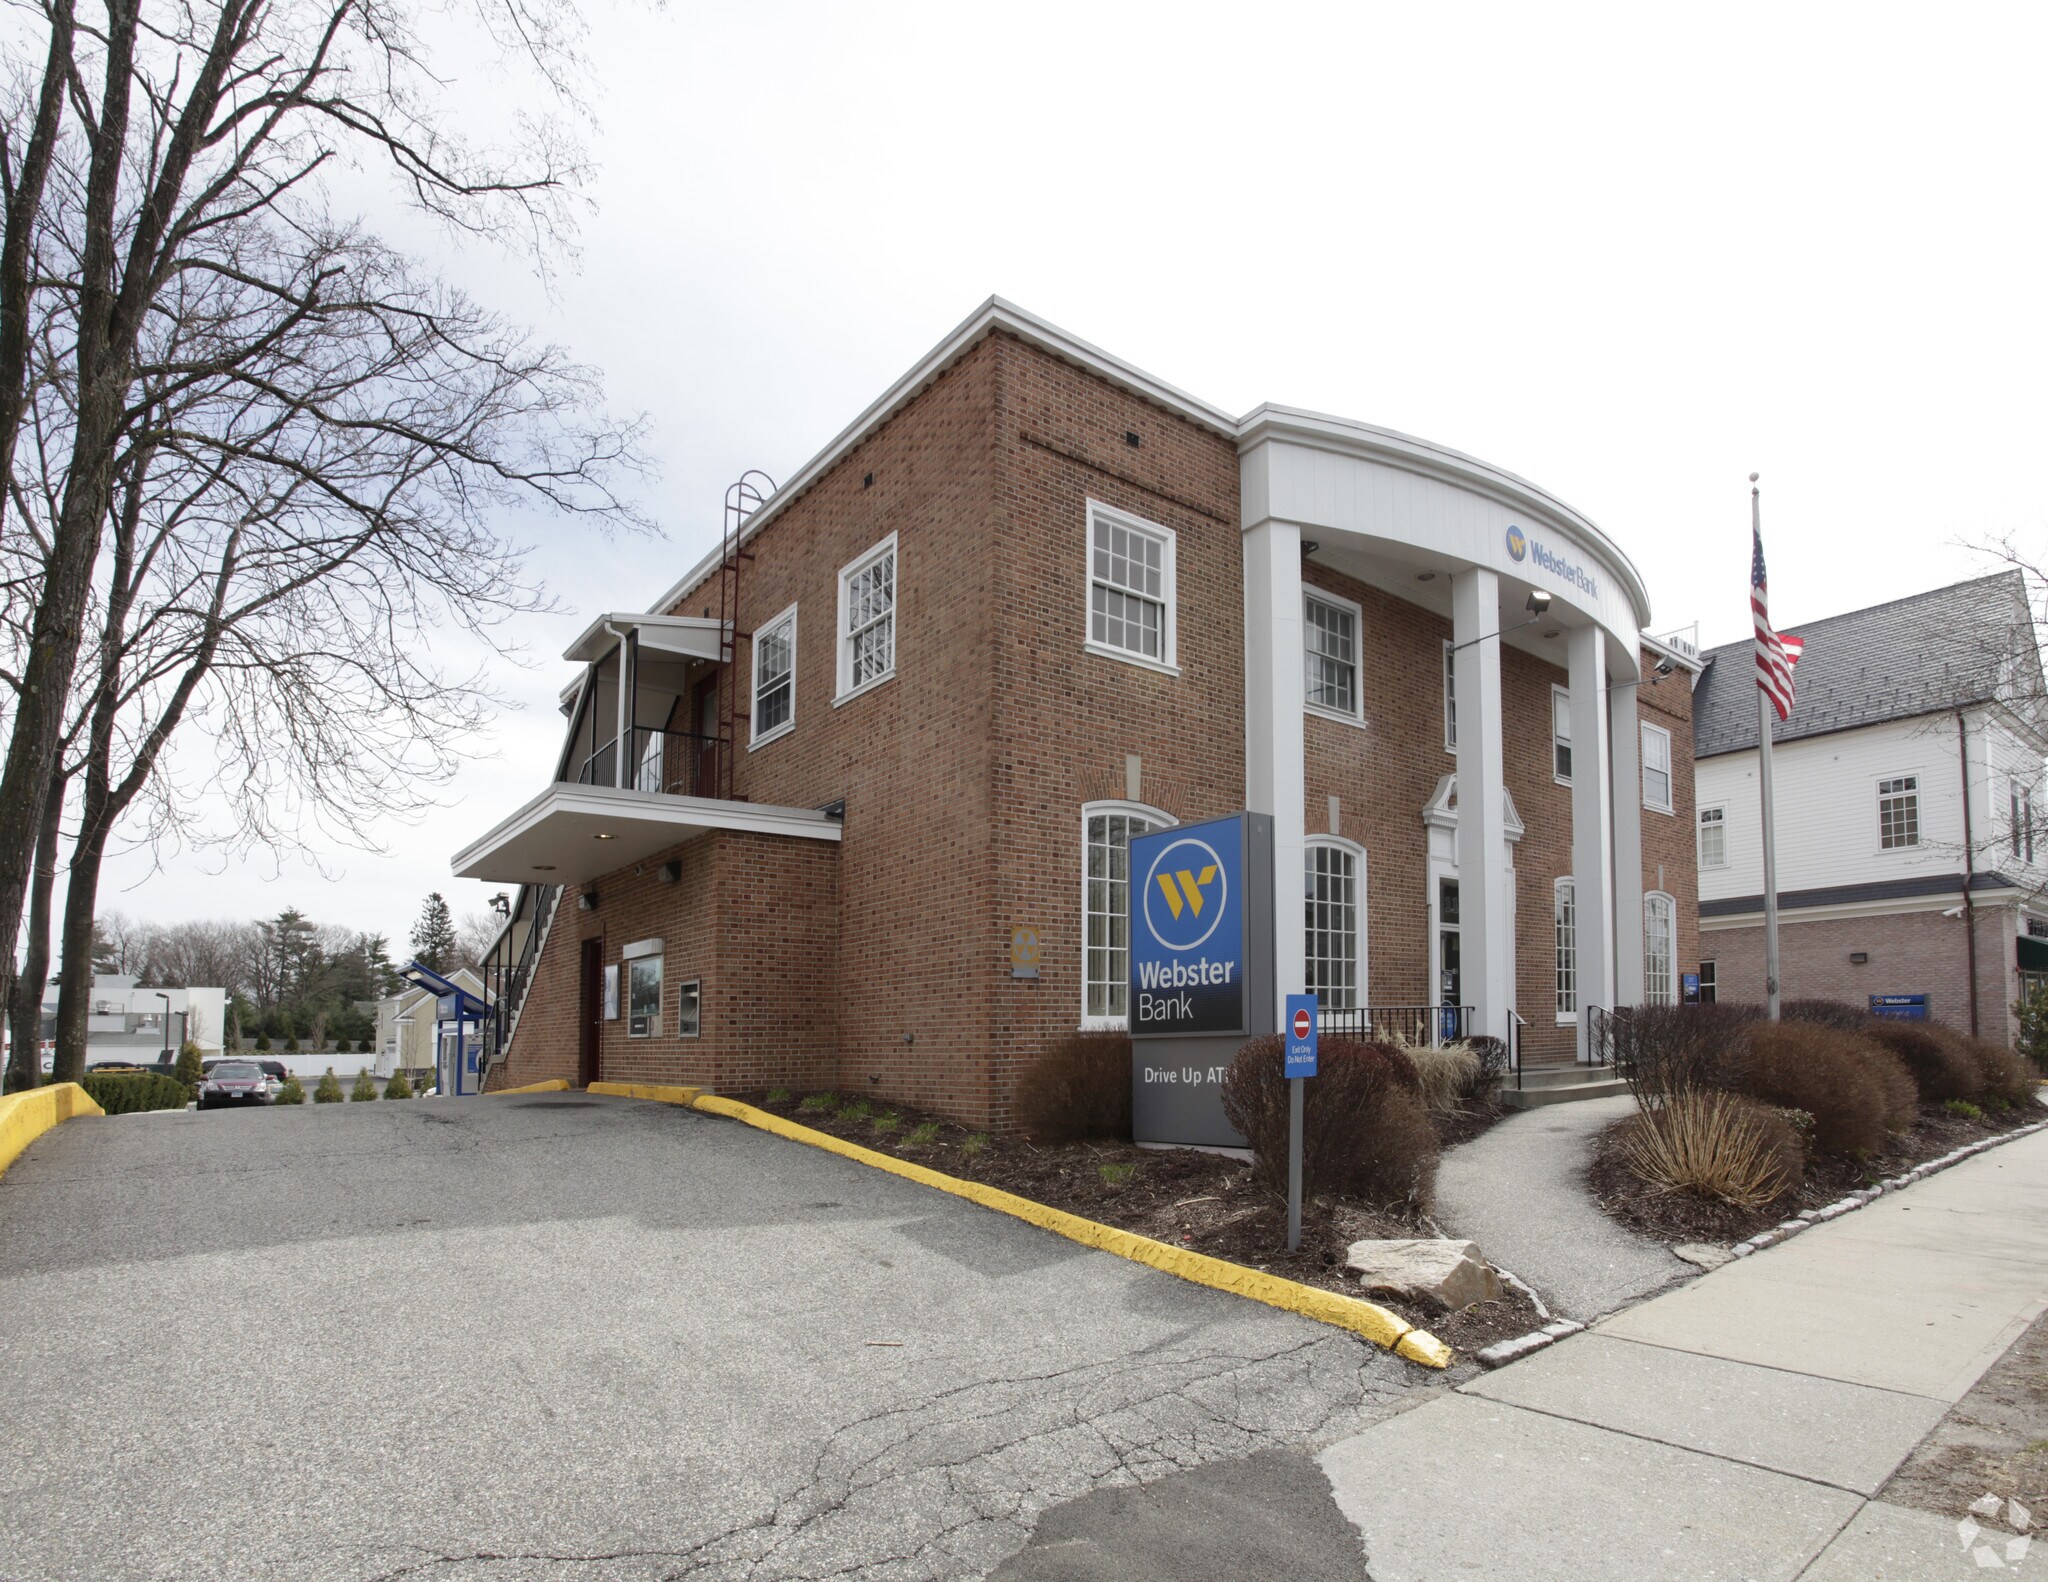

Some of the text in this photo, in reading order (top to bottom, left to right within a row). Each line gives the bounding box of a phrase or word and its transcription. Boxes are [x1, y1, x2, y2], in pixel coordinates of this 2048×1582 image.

[1530, 540, 1598, 601] Webster Bank
[1139, 957, 1235, 989] Webster
[1139, 991, 1194, 1021] Bank
[1287, 1055, 1315, 1064] Do Not Enter
[1291, 1045, 1312, 1055] Exit Only
[1144, 1066, 1238, 1087] Drive Up AT
